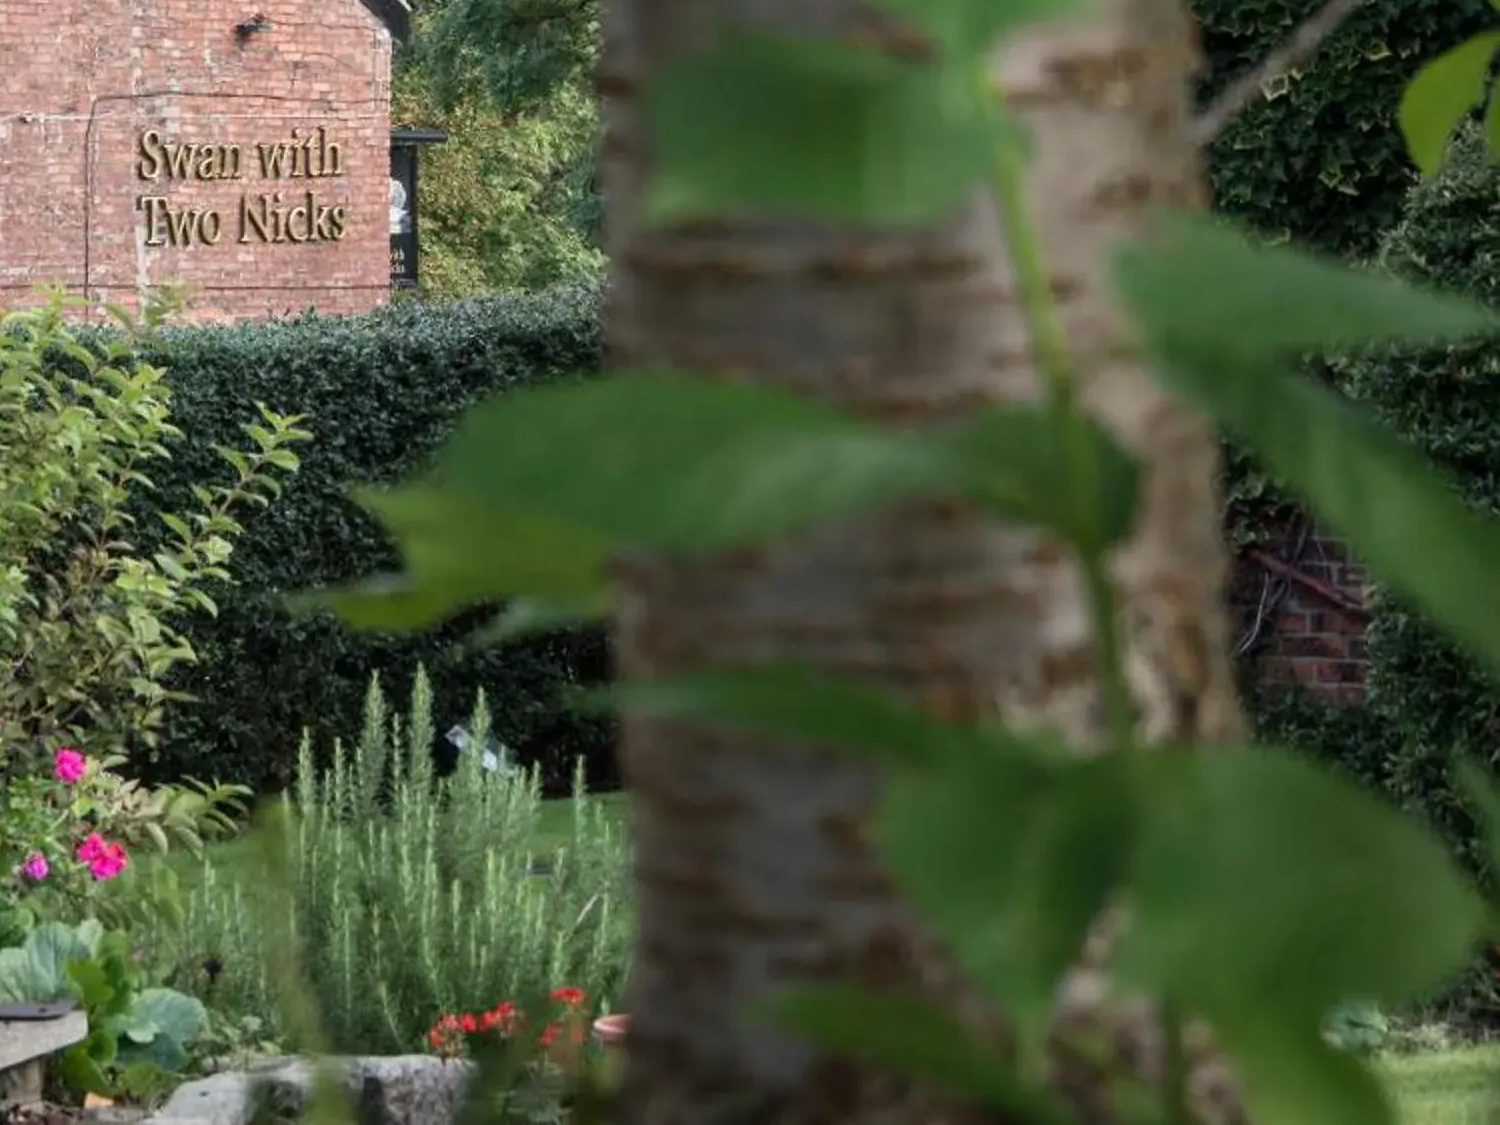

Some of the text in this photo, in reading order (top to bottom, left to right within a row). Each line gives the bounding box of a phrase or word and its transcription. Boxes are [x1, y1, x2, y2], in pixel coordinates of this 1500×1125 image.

[138, 125, 347, 180] Swan with
[136, 189, 347, 250] Two Nicks
